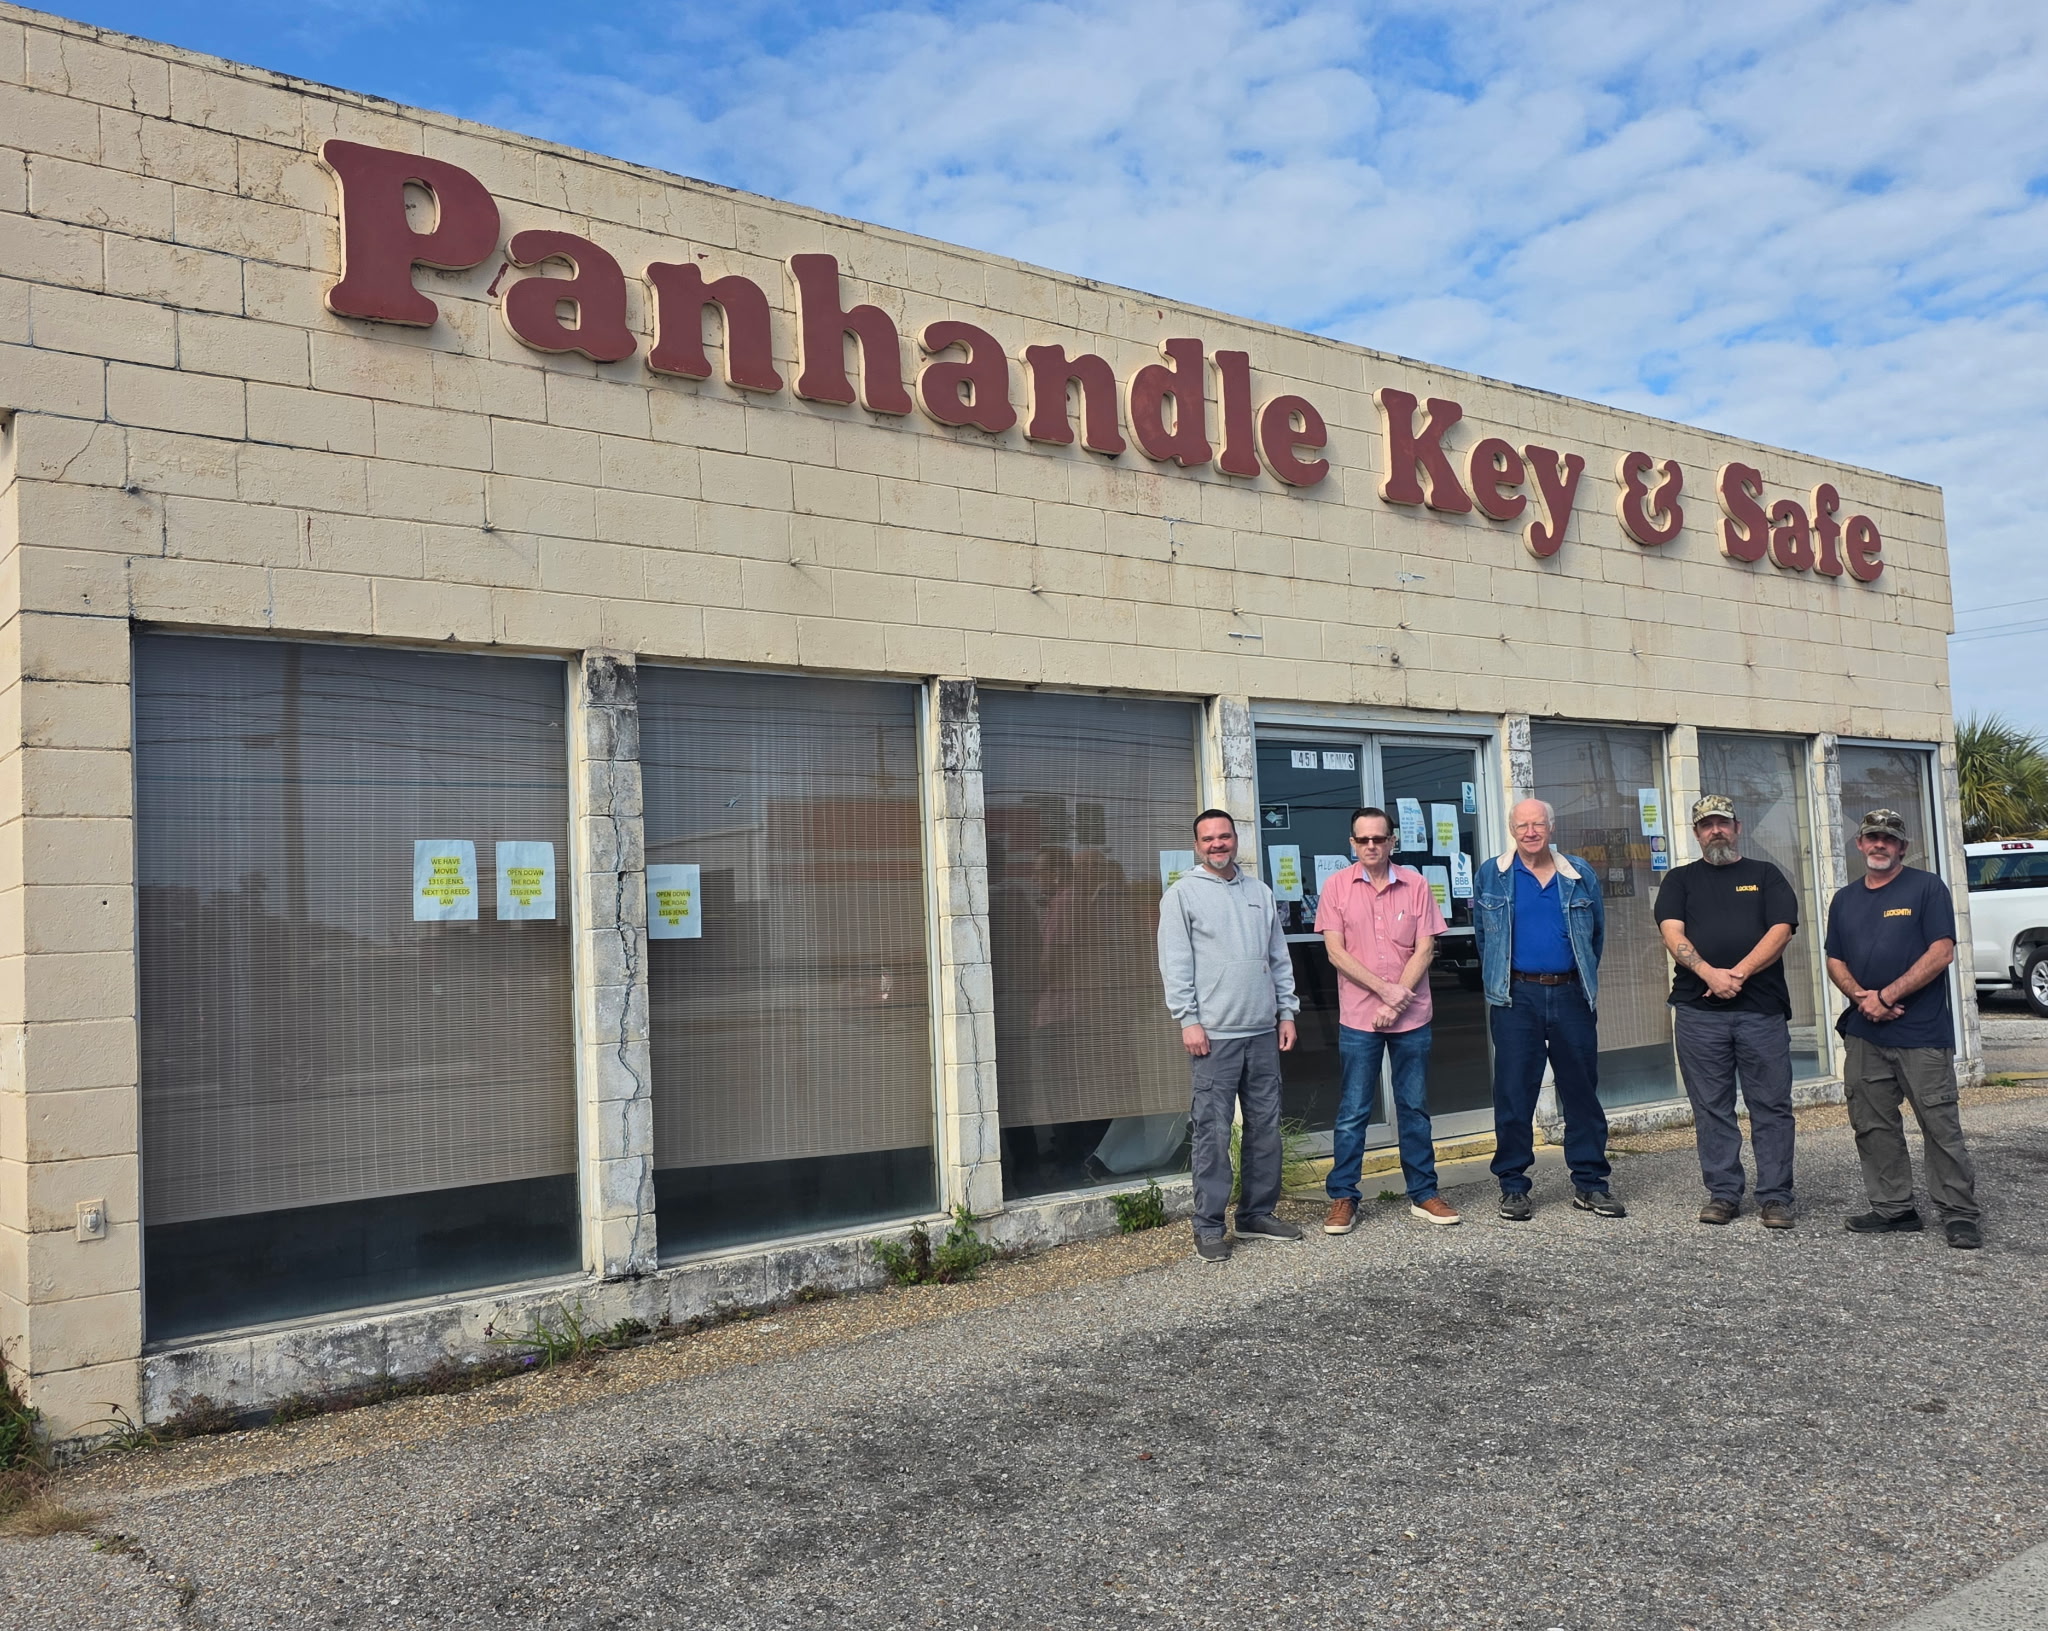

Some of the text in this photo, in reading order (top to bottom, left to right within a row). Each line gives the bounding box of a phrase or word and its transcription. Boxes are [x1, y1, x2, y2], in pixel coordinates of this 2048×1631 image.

[318, 139, 1884, 582] Panhandle Key & Safe
[1317, 859, 1333, 870] ALL
[1654, 855, 1667, 864] VISA
[1455, 877, 1469, 885] BBB
[1883, 908, 1912, 918] LOCKSMITH
